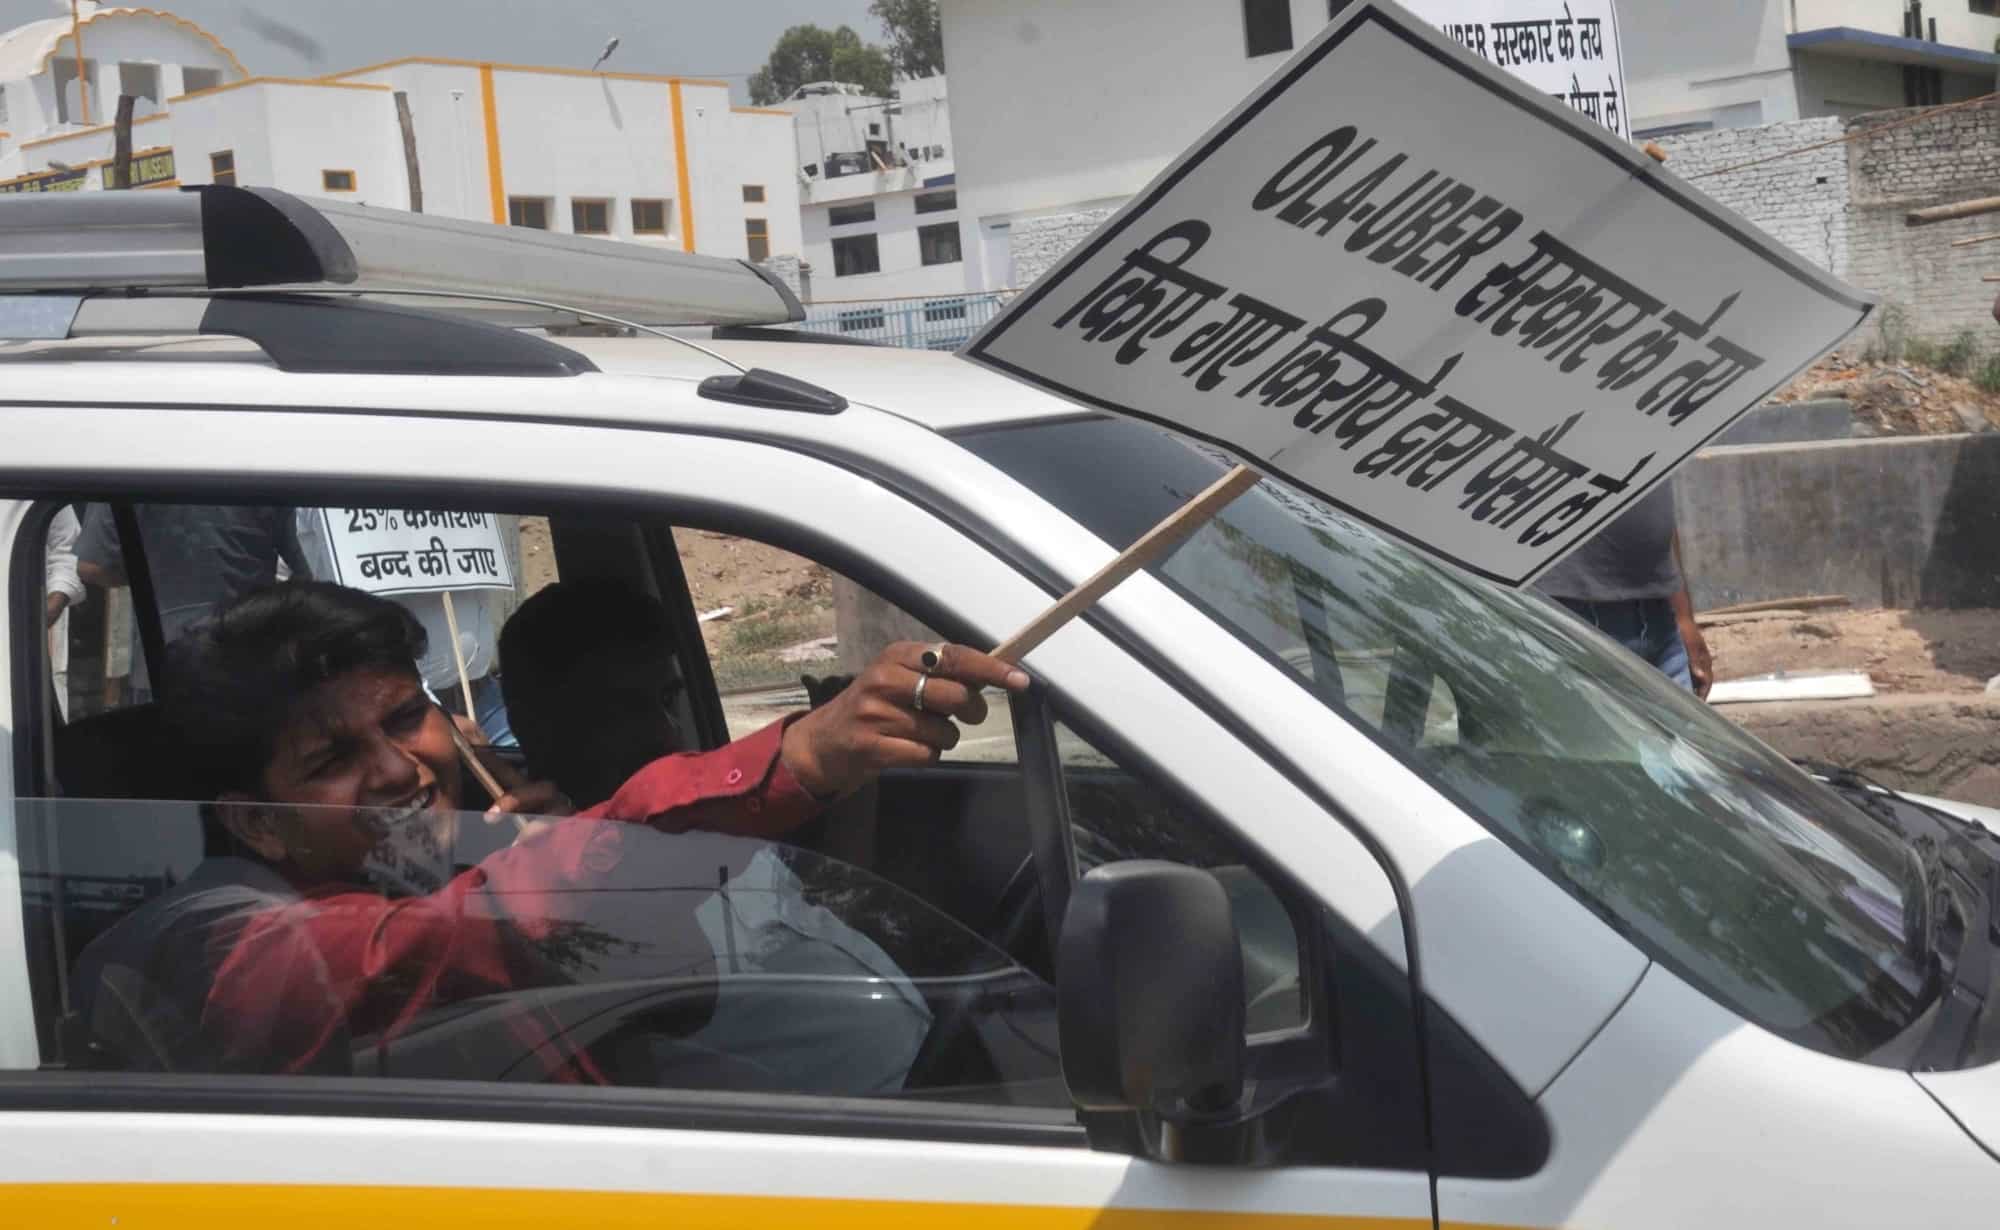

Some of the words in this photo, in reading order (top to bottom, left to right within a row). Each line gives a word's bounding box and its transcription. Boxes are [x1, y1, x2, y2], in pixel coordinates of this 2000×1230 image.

[1490, 19, 1554, 66] सरकार
[1555, 2, 1575, 62] के
[1577, 17, 1604, 61] तय
[1252, 125, 1523, 291] OLA-UBER
[1052, 219, 1229, 365] किए
[1454, 230, 1668, 373] सरकार
[1596, 290, 1742, 390] के
[1170, 293, 1307, 391] गए
[1234, 297, 1464, 450] किराये
[1635, 336, 1766, 427] तय
[1353, 395, 1516, 492] द्वारा
[1458, 411, 1591, 530] पैसा
[344, 508, 398, 532] 25%
[1517, 451, 1656, 547] ले
[357, 551, 413, 580] बन्द
[414, 536, 452, 577] की
[452, 549, 498, 576] जाए
